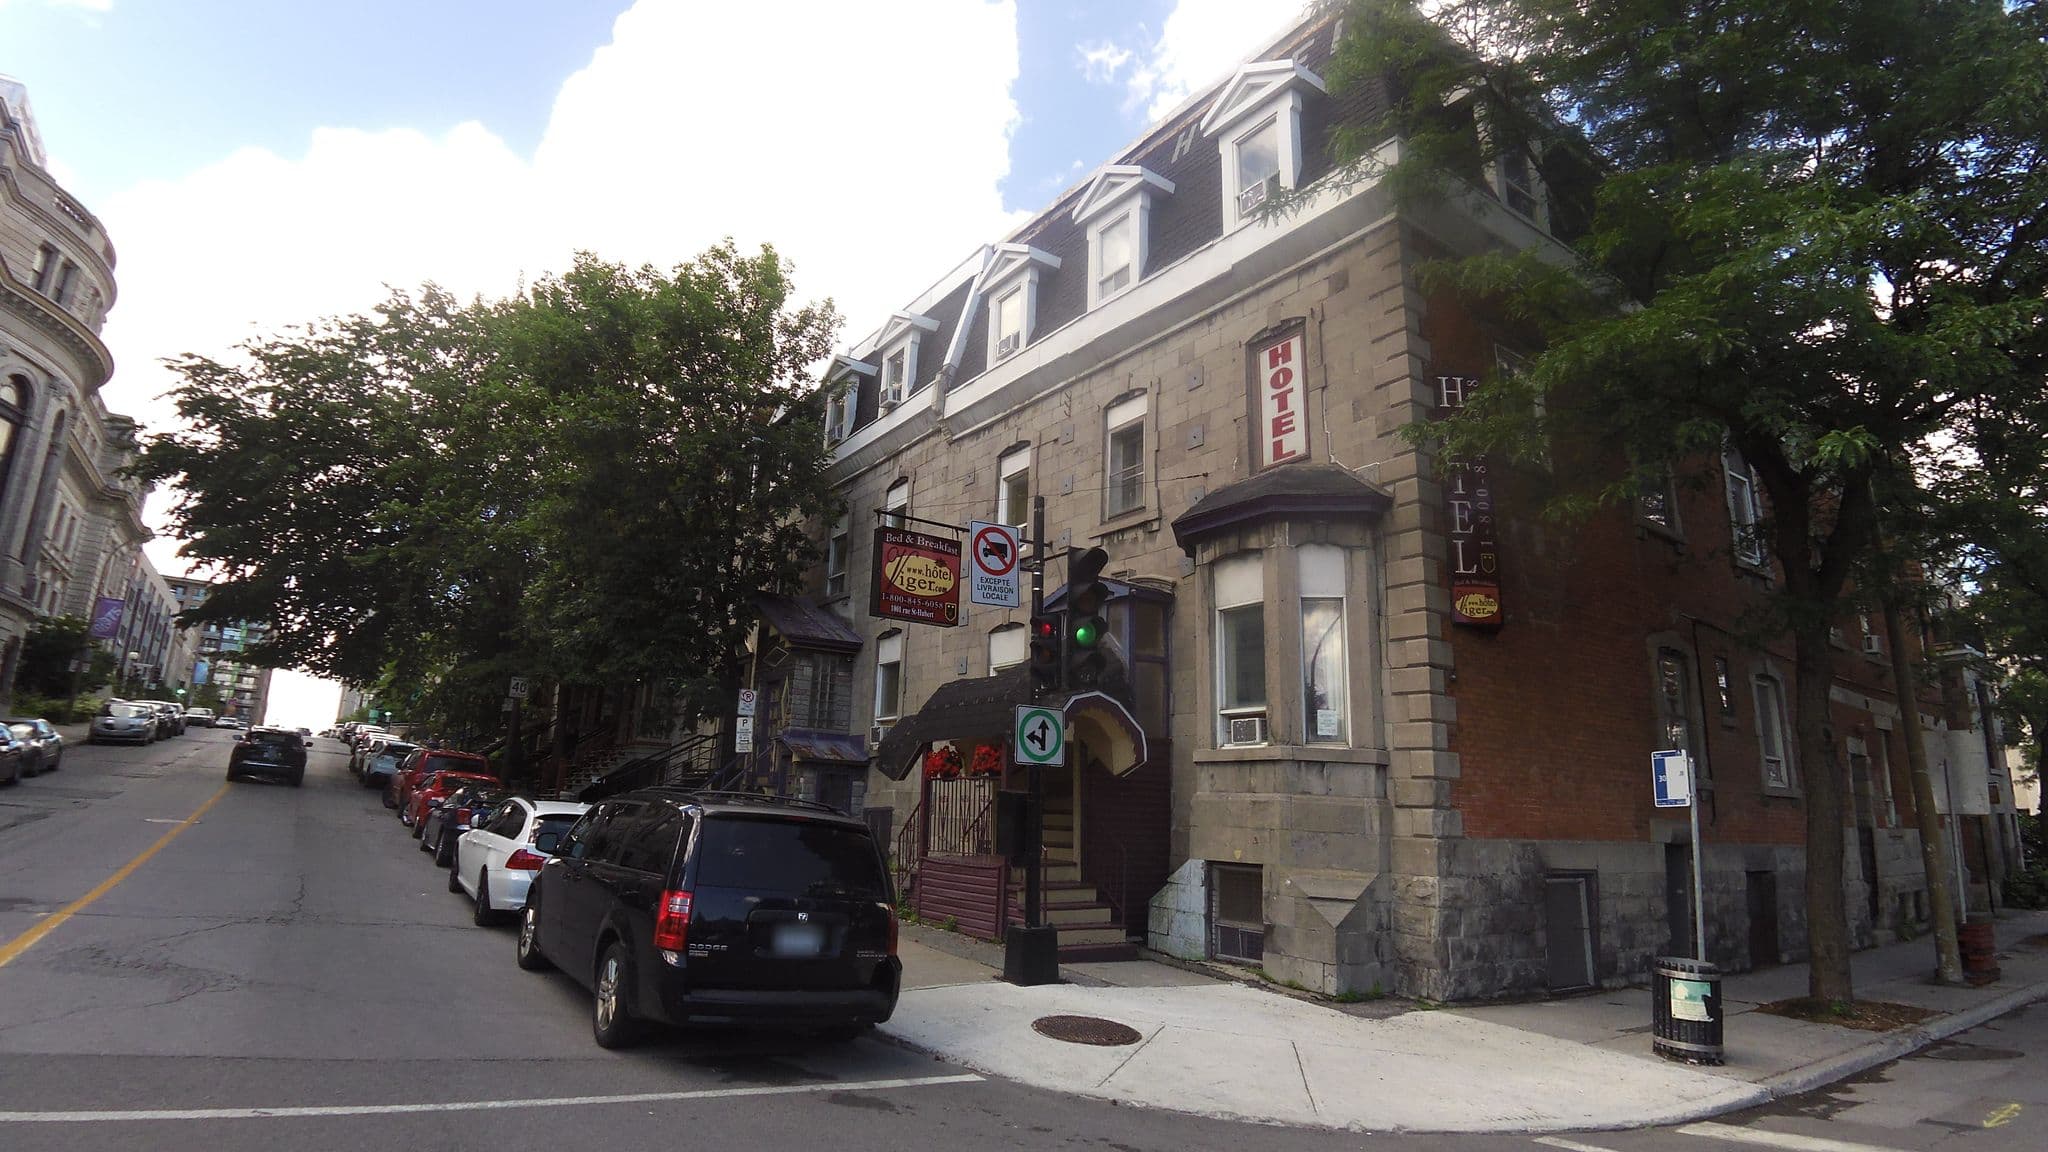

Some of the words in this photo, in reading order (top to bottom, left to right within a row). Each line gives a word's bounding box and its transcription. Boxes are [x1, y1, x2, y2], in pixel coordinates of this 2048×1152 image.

[1269, 341, 1297, 462] HOTEL
[1437, 376, 1478, 574] HTEL
[886, 532, 903, 542] Bed
[905, 534, 914, 544] &
[917, 536, 958, 556] Breakfast
[976, 583, 1014, 594] LIVRAISON
[982, 591, 1009, 601] LOCALE
[689, 943, 729, 951] DODGE
